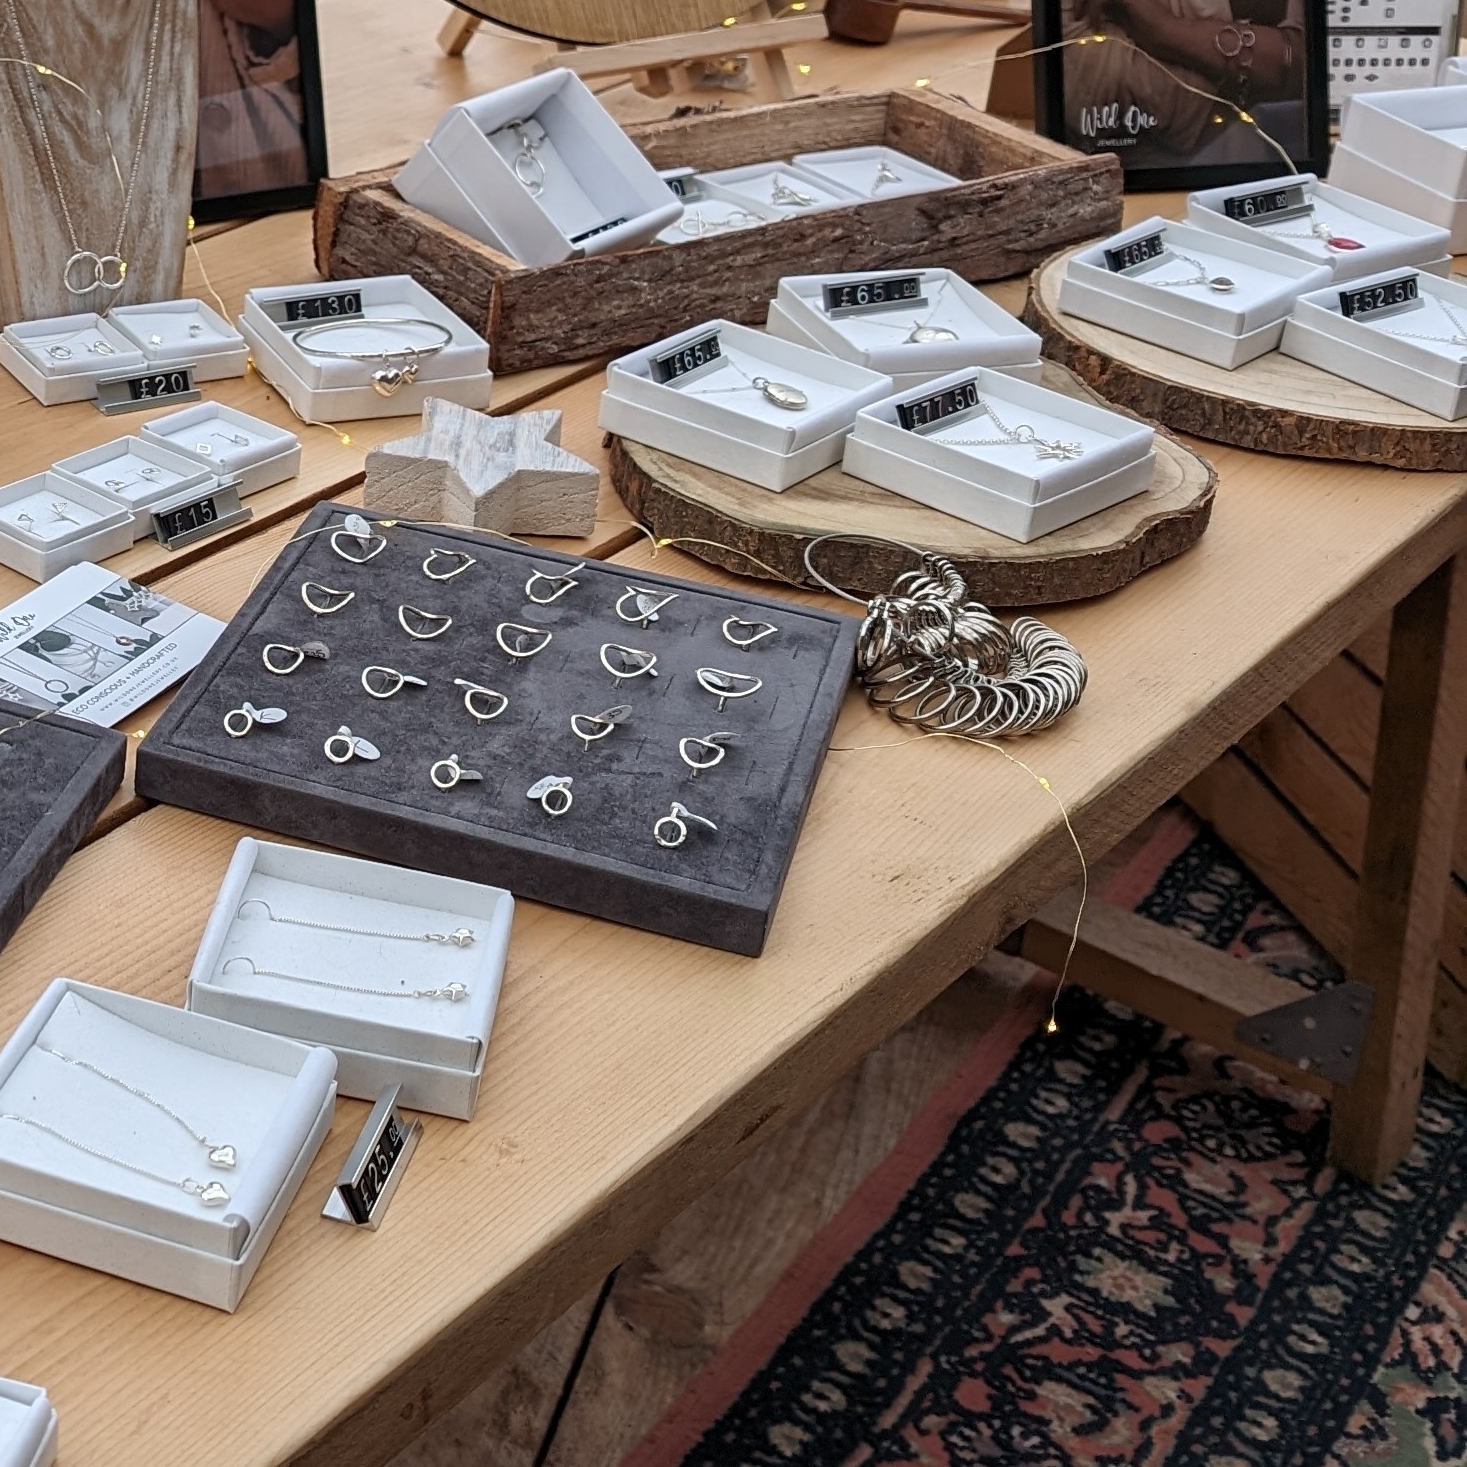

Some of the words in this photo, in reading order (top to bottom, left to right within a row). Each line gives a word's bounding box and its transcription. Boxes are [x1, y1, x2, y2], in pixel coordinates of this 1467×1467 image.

[1080, 101, 1120, 138] Wild
[1124, 104, 1159, 134] One
[295, 293, 358, 321] £130
[839, 281, 919, 308] £65.00
[1352, 280, 1415, 315] £52.50
[140, 372, 185, 400] £20
[911, 383, 978, 428] £77.50
[174, 500, 213, 534] £15
[71, 704, 89, 715] ECO
[86, 678, 127, 706] CONSCIOUS
[128, 642, 178, 677] HANDCRAFTED
[359, 1120, 400, 1212] £25.00
